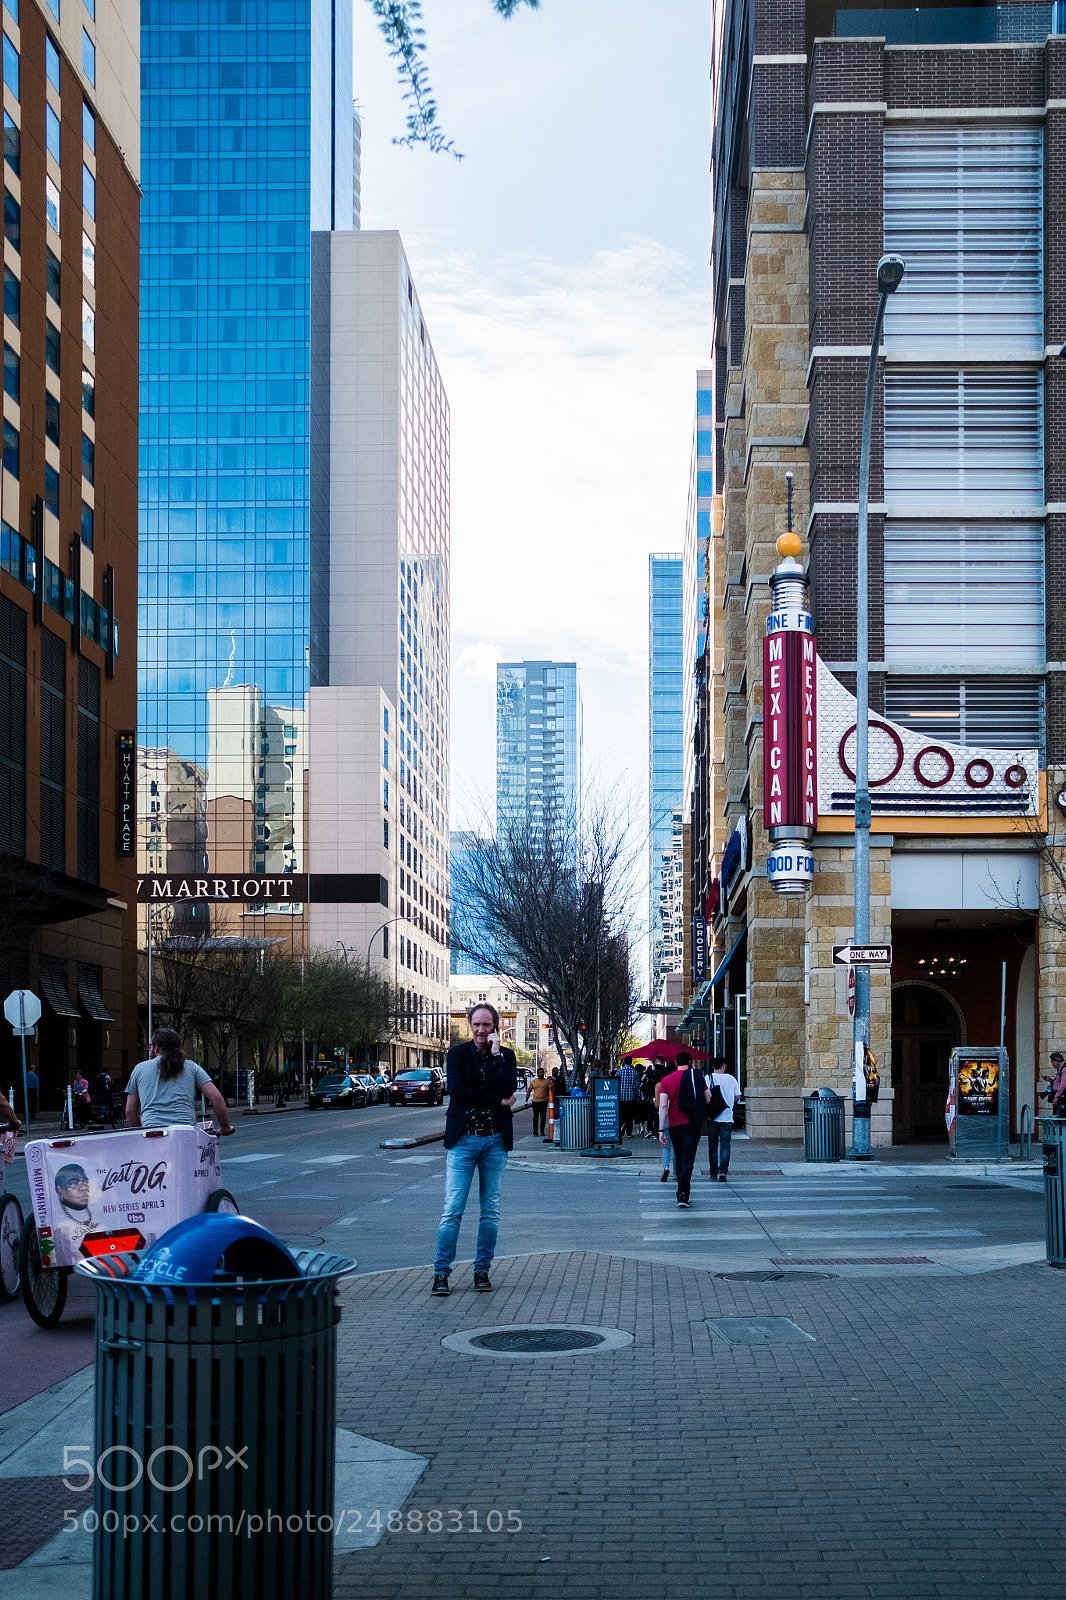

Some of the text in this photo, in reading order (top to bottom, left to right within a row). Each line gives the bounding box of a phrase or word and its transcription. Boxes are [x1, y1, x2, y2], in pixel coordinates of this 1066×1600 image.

[769, 638, 782, 824] MEXICAN
[803, 638, 814, 824] MEXICAN
[122, 754, 131, 851] HYATT PLACE
[150, 880, 293, 897] MARRIOTT
[696, 922, 704, 975] GROCERY
[850, 951, 885, 959] ONE WAY
[31, 1150, 40, 1159] 27
[102, 1160, 143, 1192] Last
[131, 1161, 168, 1194] O.G.
[33, 1167, 47, 1216] MOVEMINT
[103, 1199, 165, 1214] NEW SERIES APRIL 3
[128, 1213, 145, 1223] tbs
[138, 1259, 187, 1280] ECYCLE
